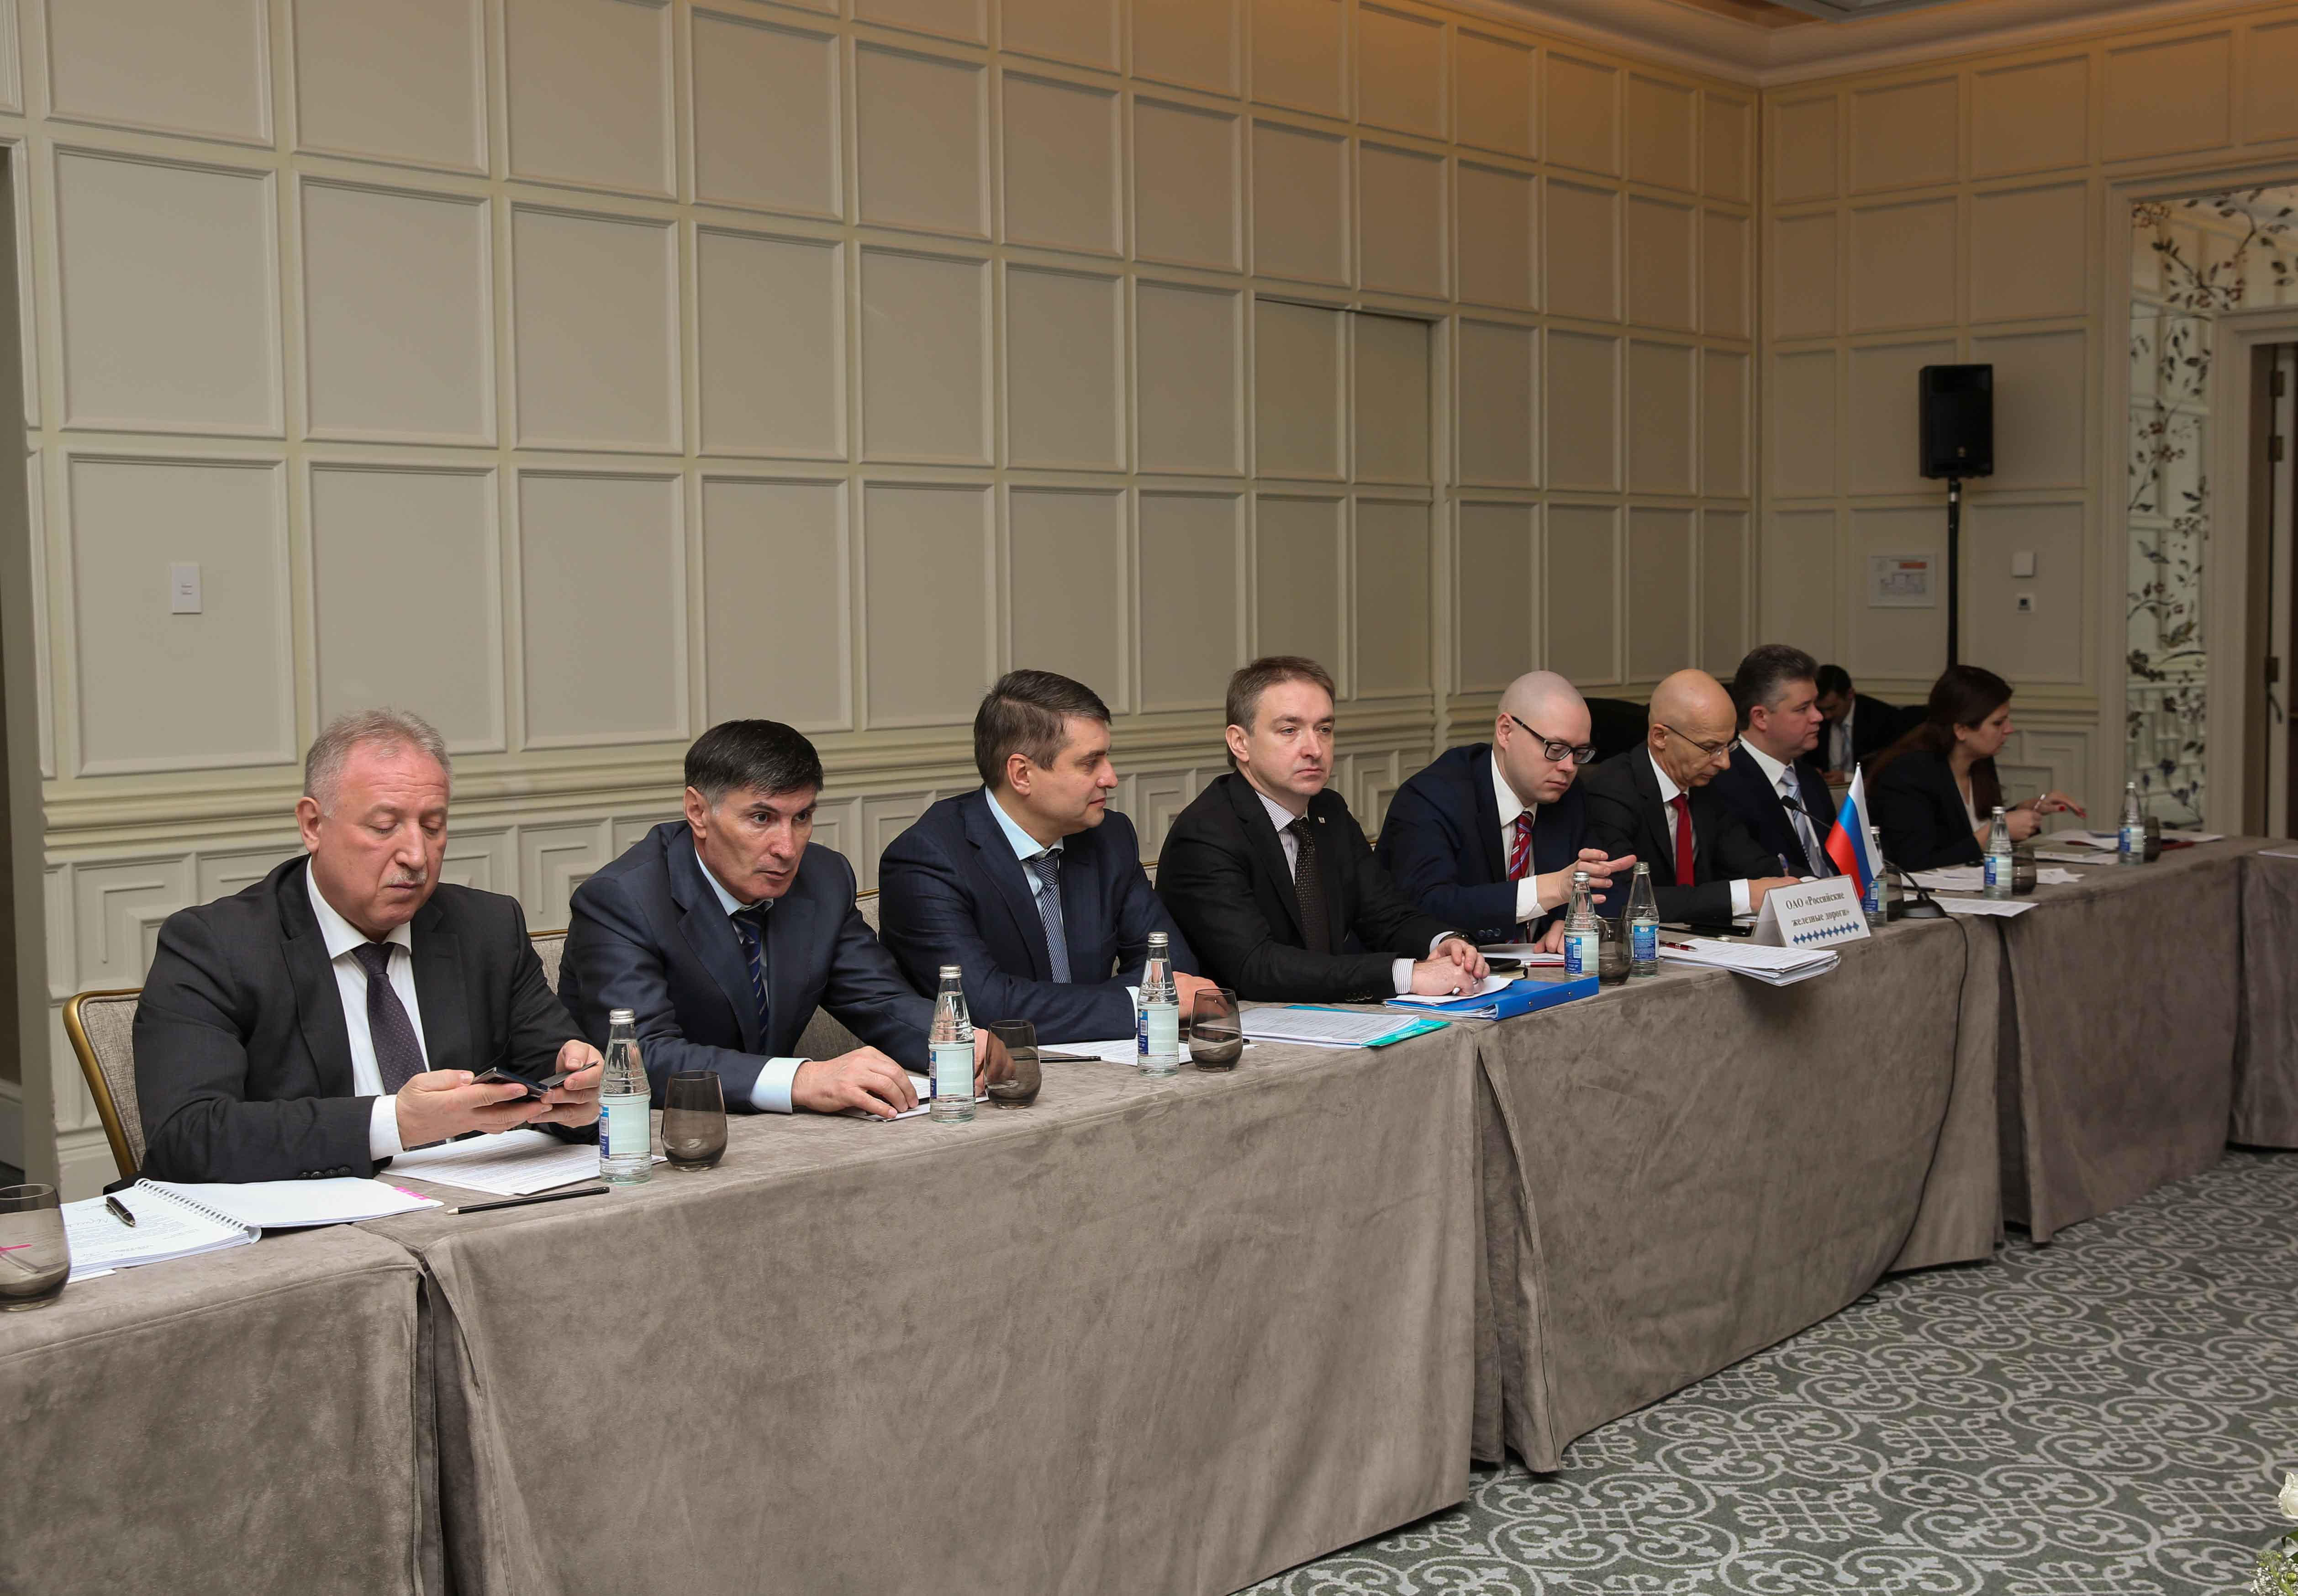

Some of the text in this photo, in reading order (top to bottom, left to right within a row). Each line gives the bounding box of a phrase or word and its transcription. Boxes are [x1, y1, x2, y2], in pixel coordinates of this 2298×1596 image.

[1786, 892, 1845, 910] ОАО «Российские
[1792, 909, 1850, 927] железные дороги»
